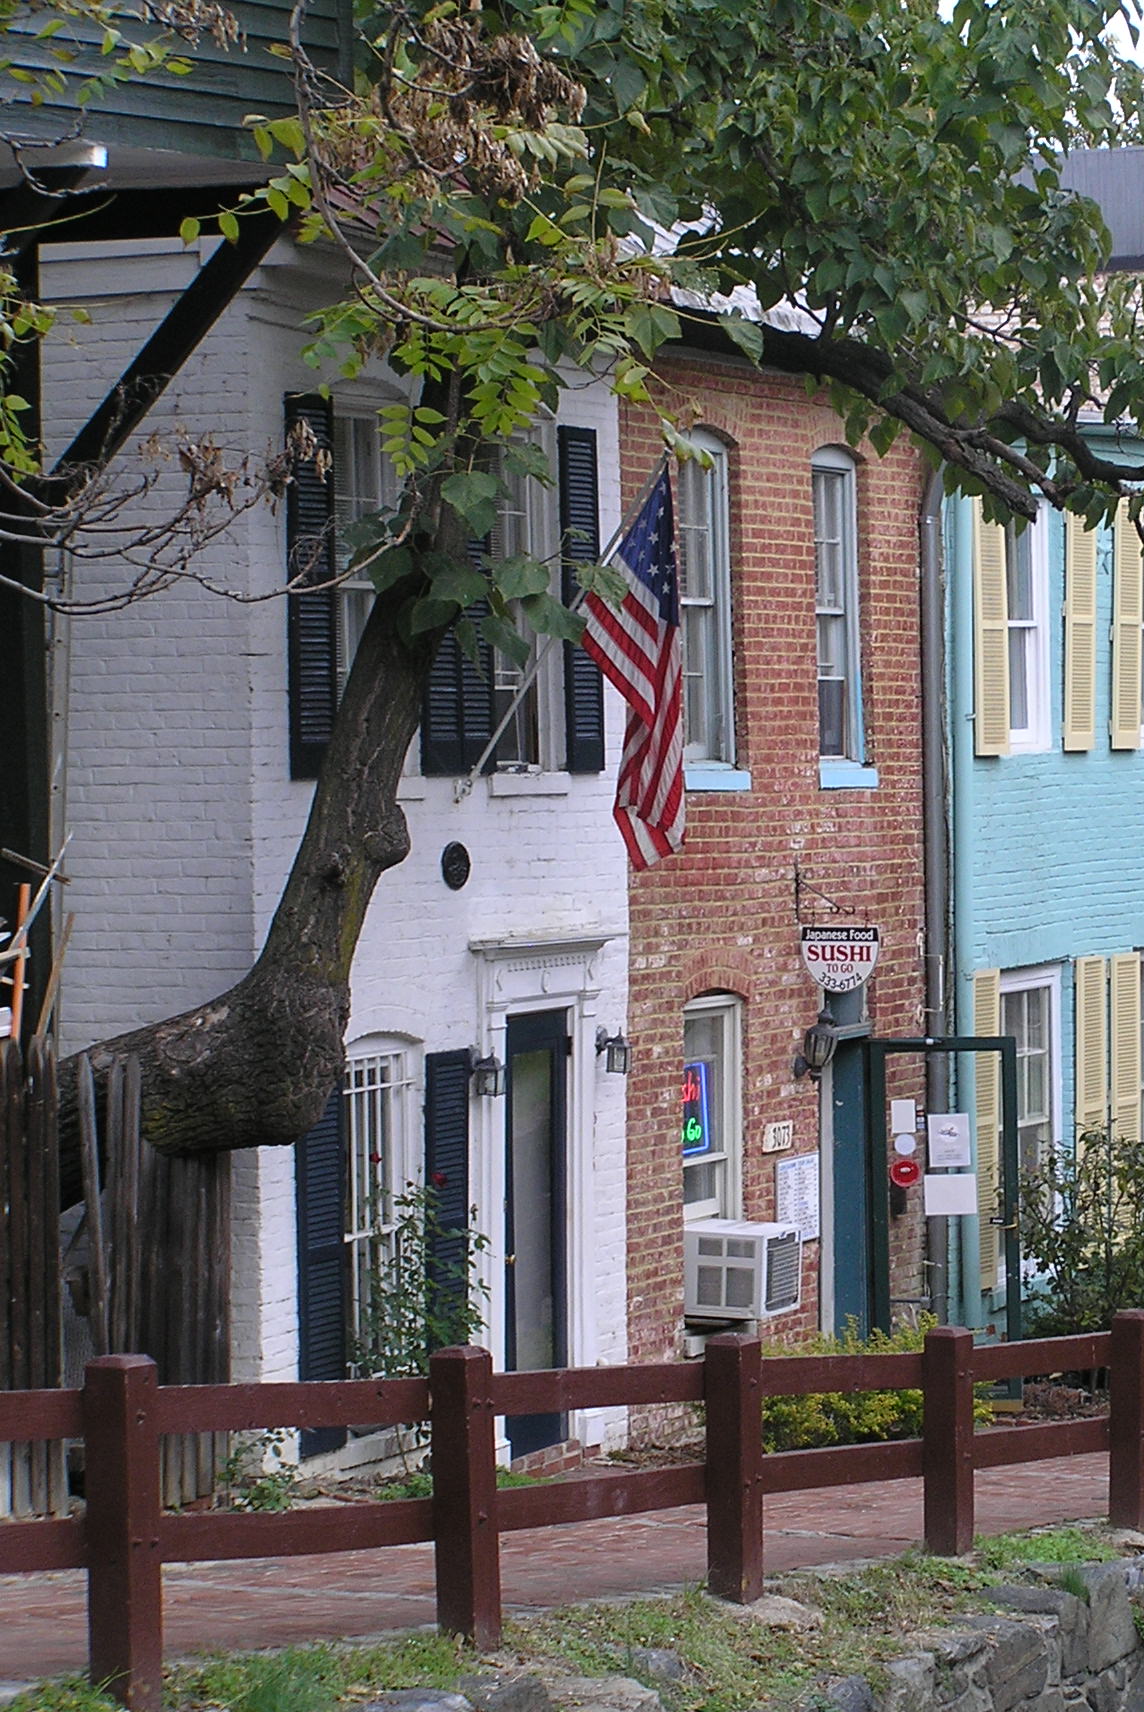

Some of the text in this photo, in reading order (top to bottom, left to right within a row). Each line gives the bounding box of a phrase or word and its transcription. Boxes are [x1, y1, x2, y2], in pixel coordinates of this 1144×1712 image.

[806, 929, 873, 941] Japanese Food
[808, 945, 871, 962] SUSHI
[826, 964, 853, 973] TO GO
[819, 972, 862, 990] 333-6774
[687, 1118, 701, 1141] Go
[772, 1125, 790, 1148] 3073
